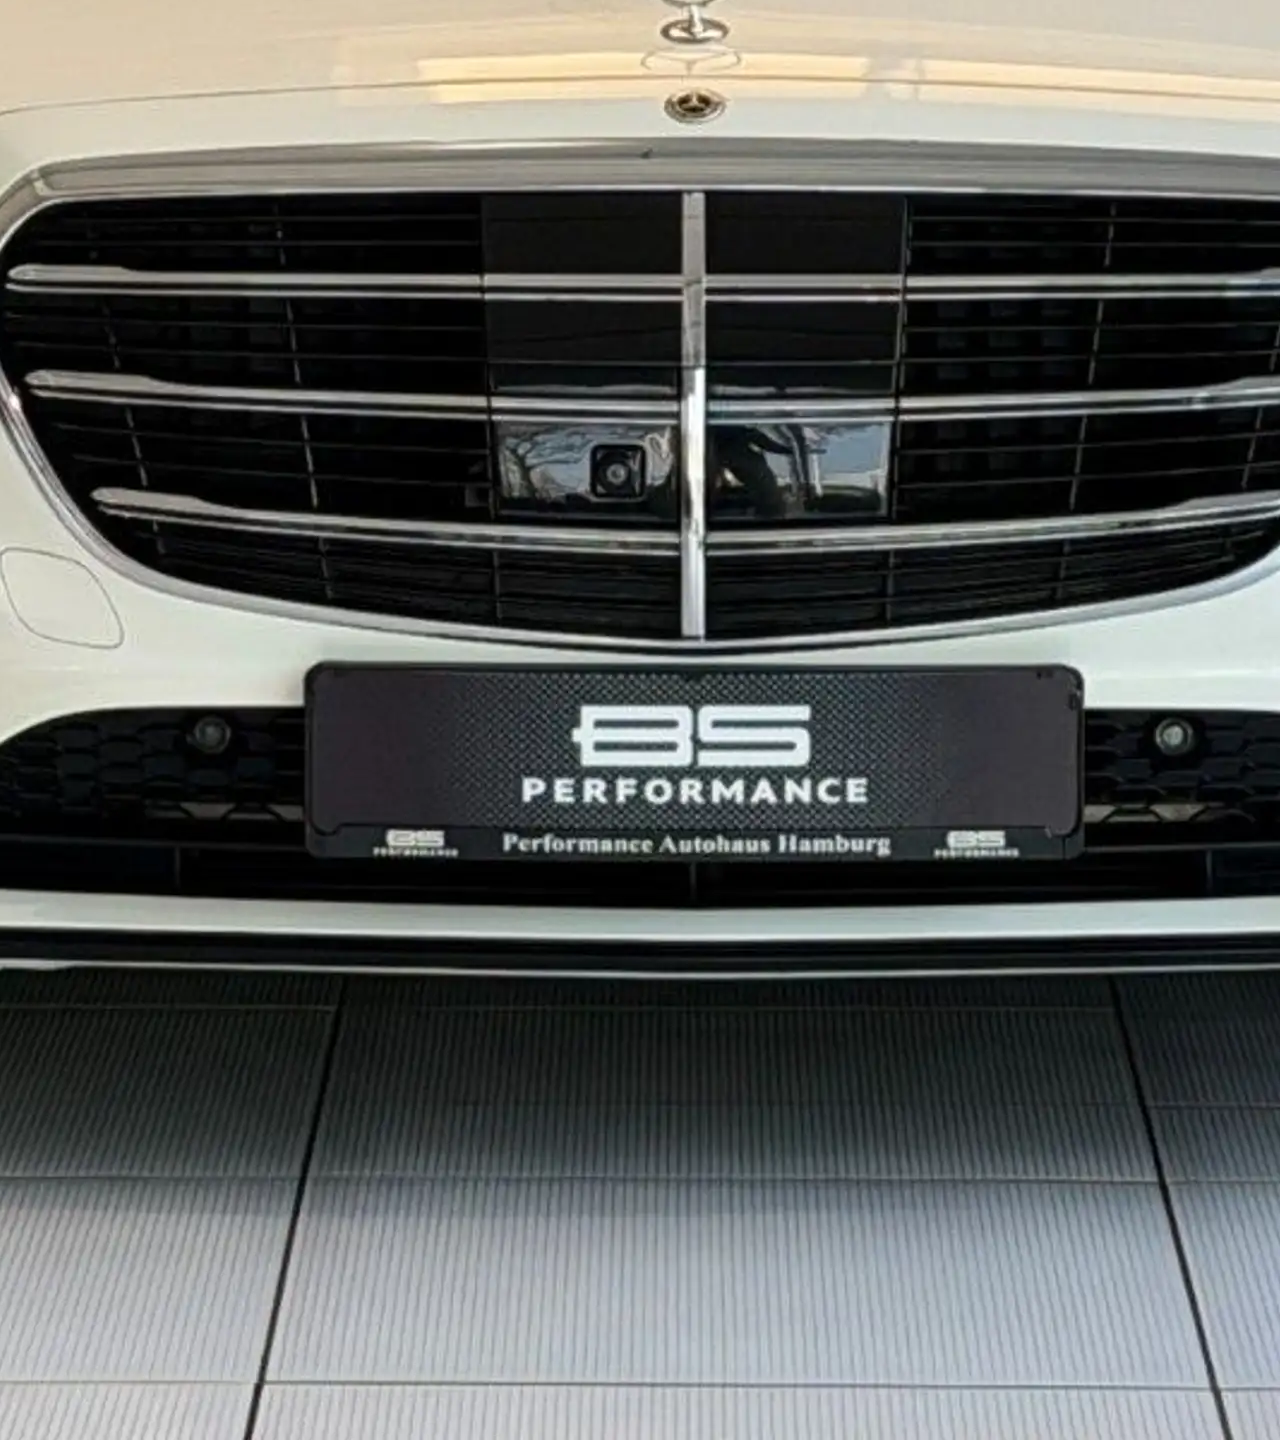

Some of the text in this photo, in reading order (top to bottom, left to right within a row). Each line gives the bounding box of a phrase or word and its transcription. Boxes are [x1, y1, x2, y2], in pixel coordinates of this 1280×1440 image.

[521, 777, 869, 805] PERFORMANCE
[502, 832, 892, 858] Performance Autohaus Hamburg
